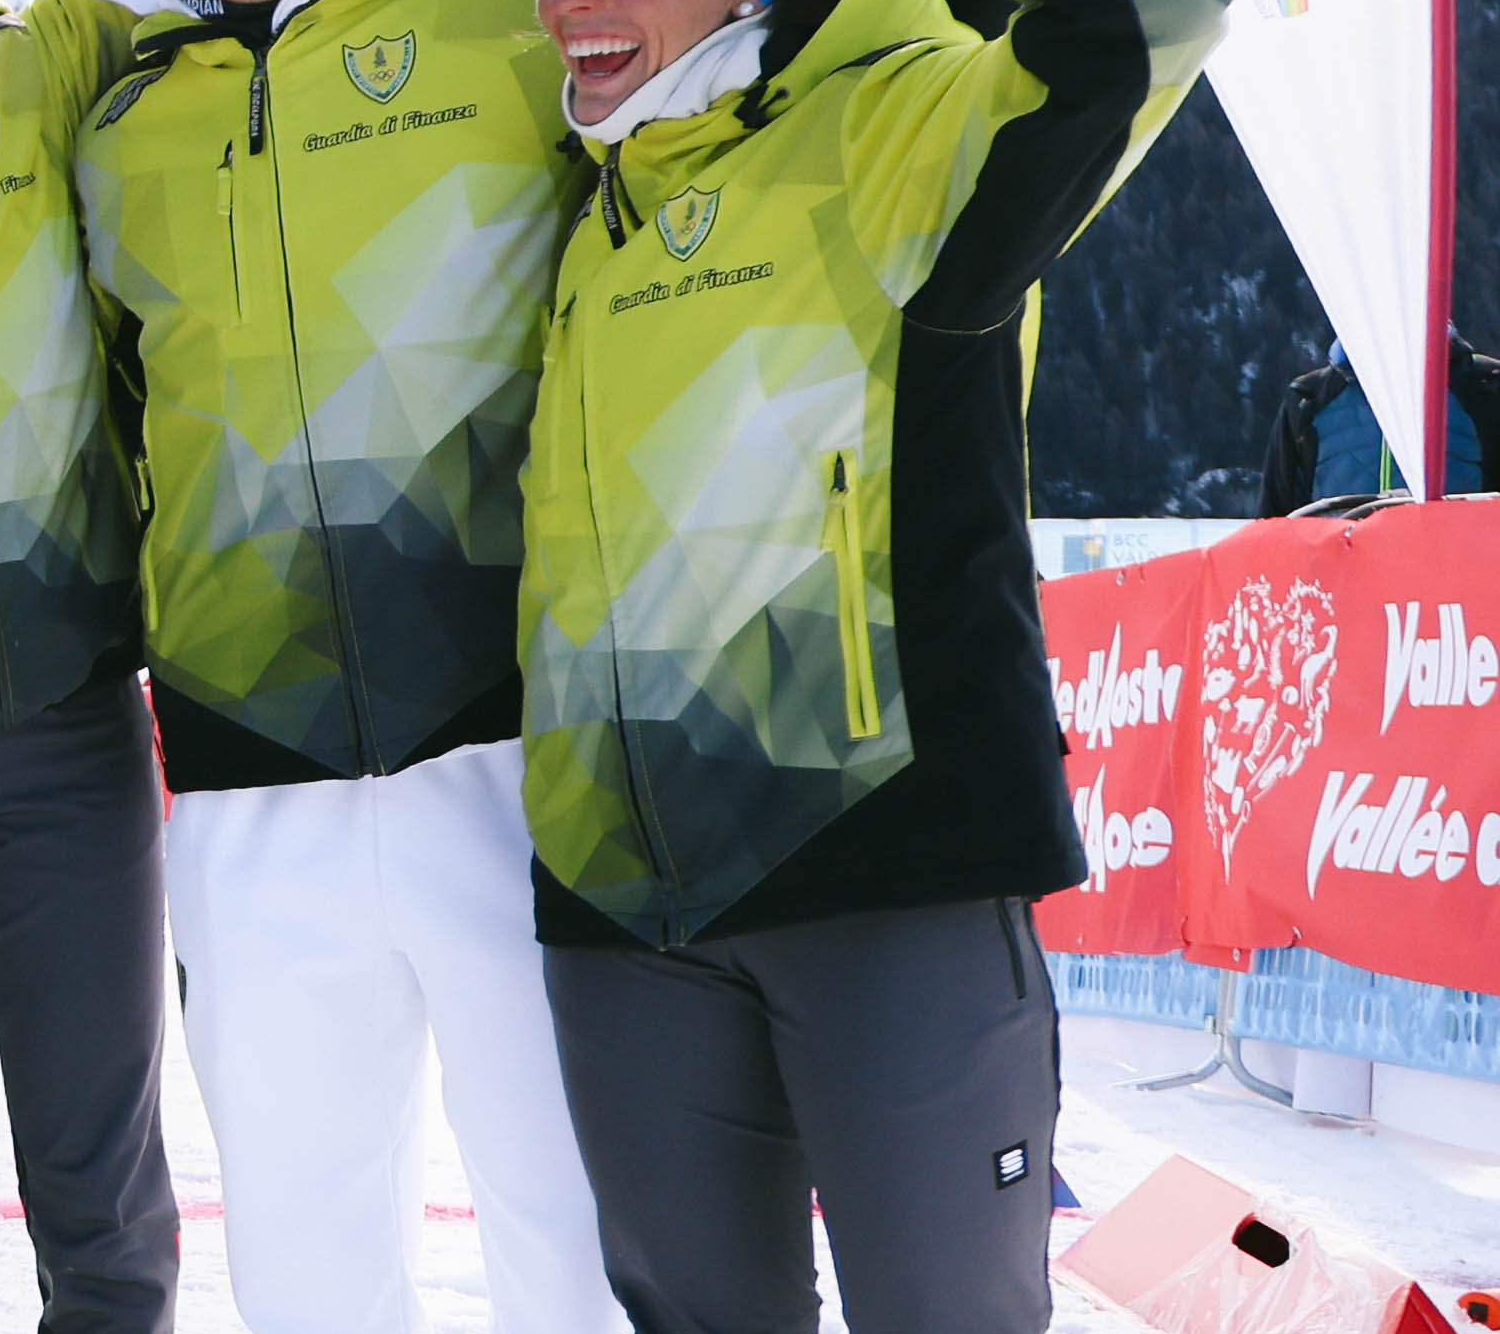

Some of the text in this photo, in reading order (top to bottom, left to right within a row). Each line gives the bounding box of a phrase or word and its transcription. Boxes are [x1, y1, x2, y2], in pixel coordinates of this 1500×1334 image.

[303, 104, 478, 153] Guardia di Finanza
[675, 274, 695, 297] di
[696, 262, 774, 293] Finanza
[1380, 601, 1499, 738] Valle
[1307, 770, 1470, 901] Vallée
